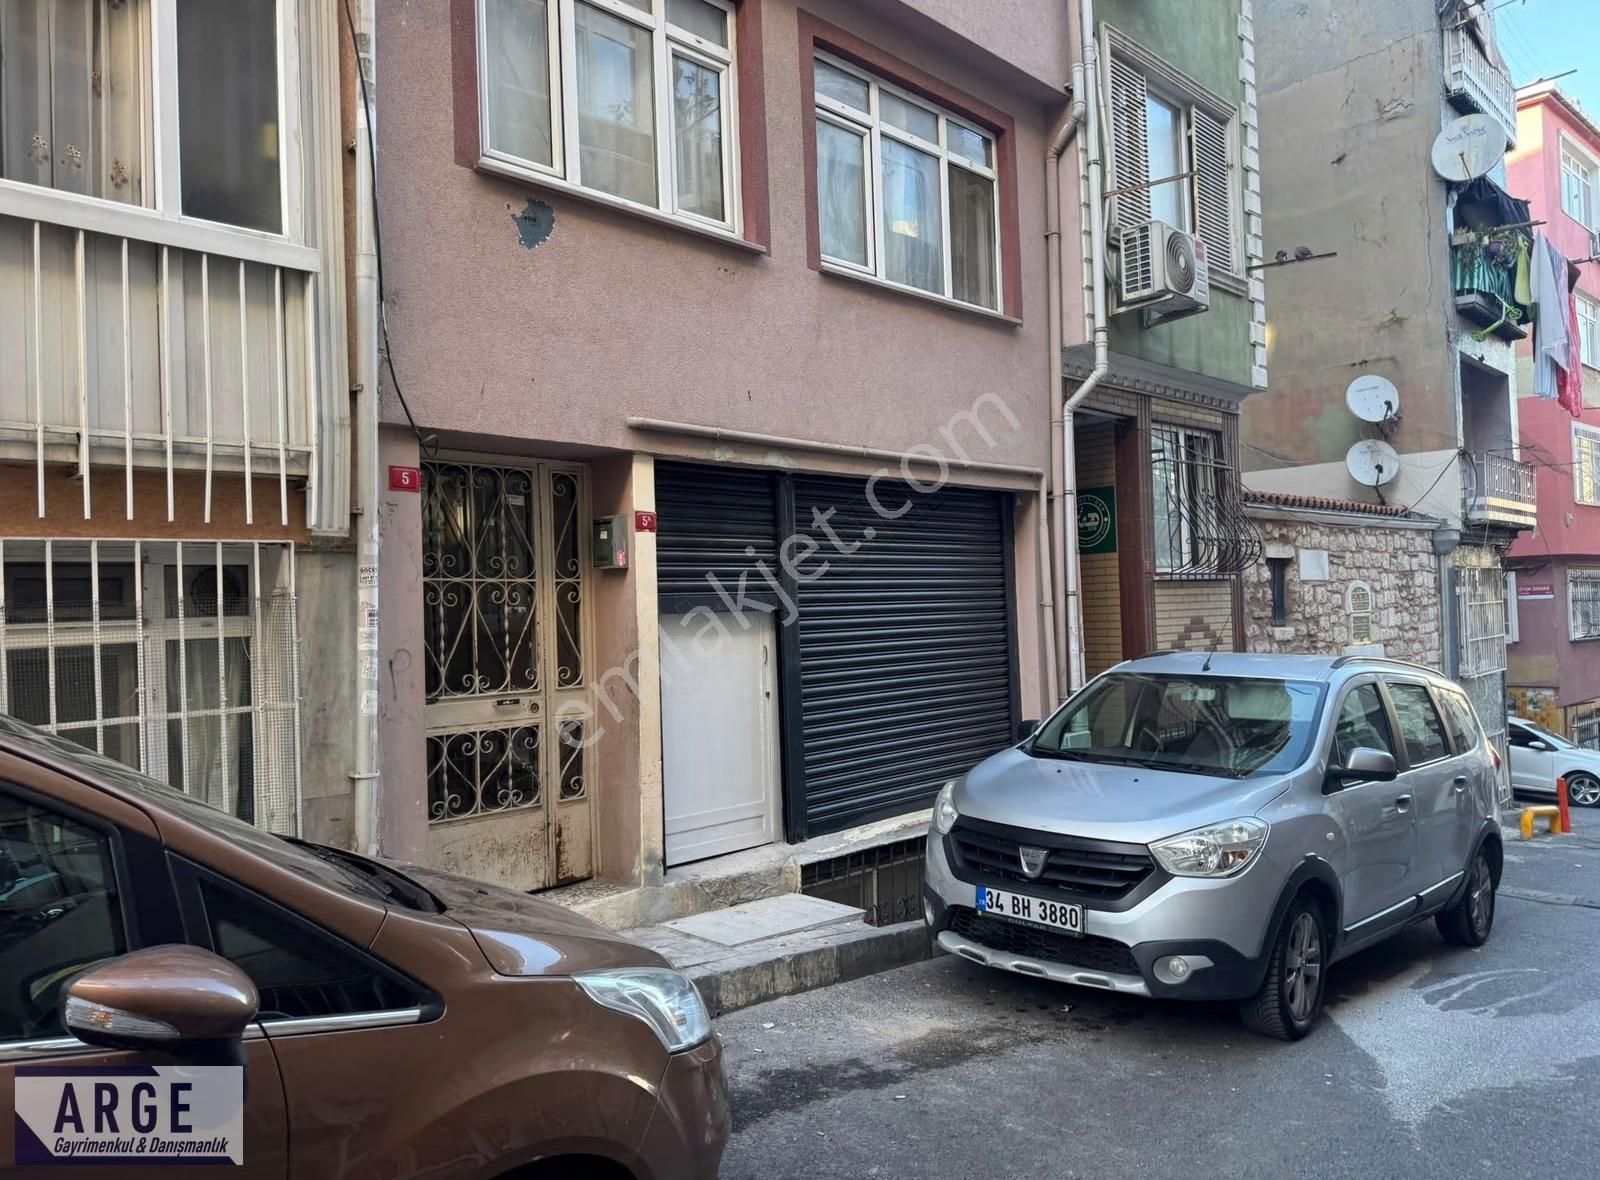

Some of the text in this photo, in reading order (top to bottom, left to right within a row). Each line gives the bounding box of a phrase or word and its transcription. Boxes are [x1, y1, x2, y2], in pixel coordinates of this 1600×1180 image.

[402, 472, 409, 485] 5
[986, 890, 1004, 912] 34
[1012, 896, 1031, 918] BH
[1039, 901, 1079, 929] 3880
